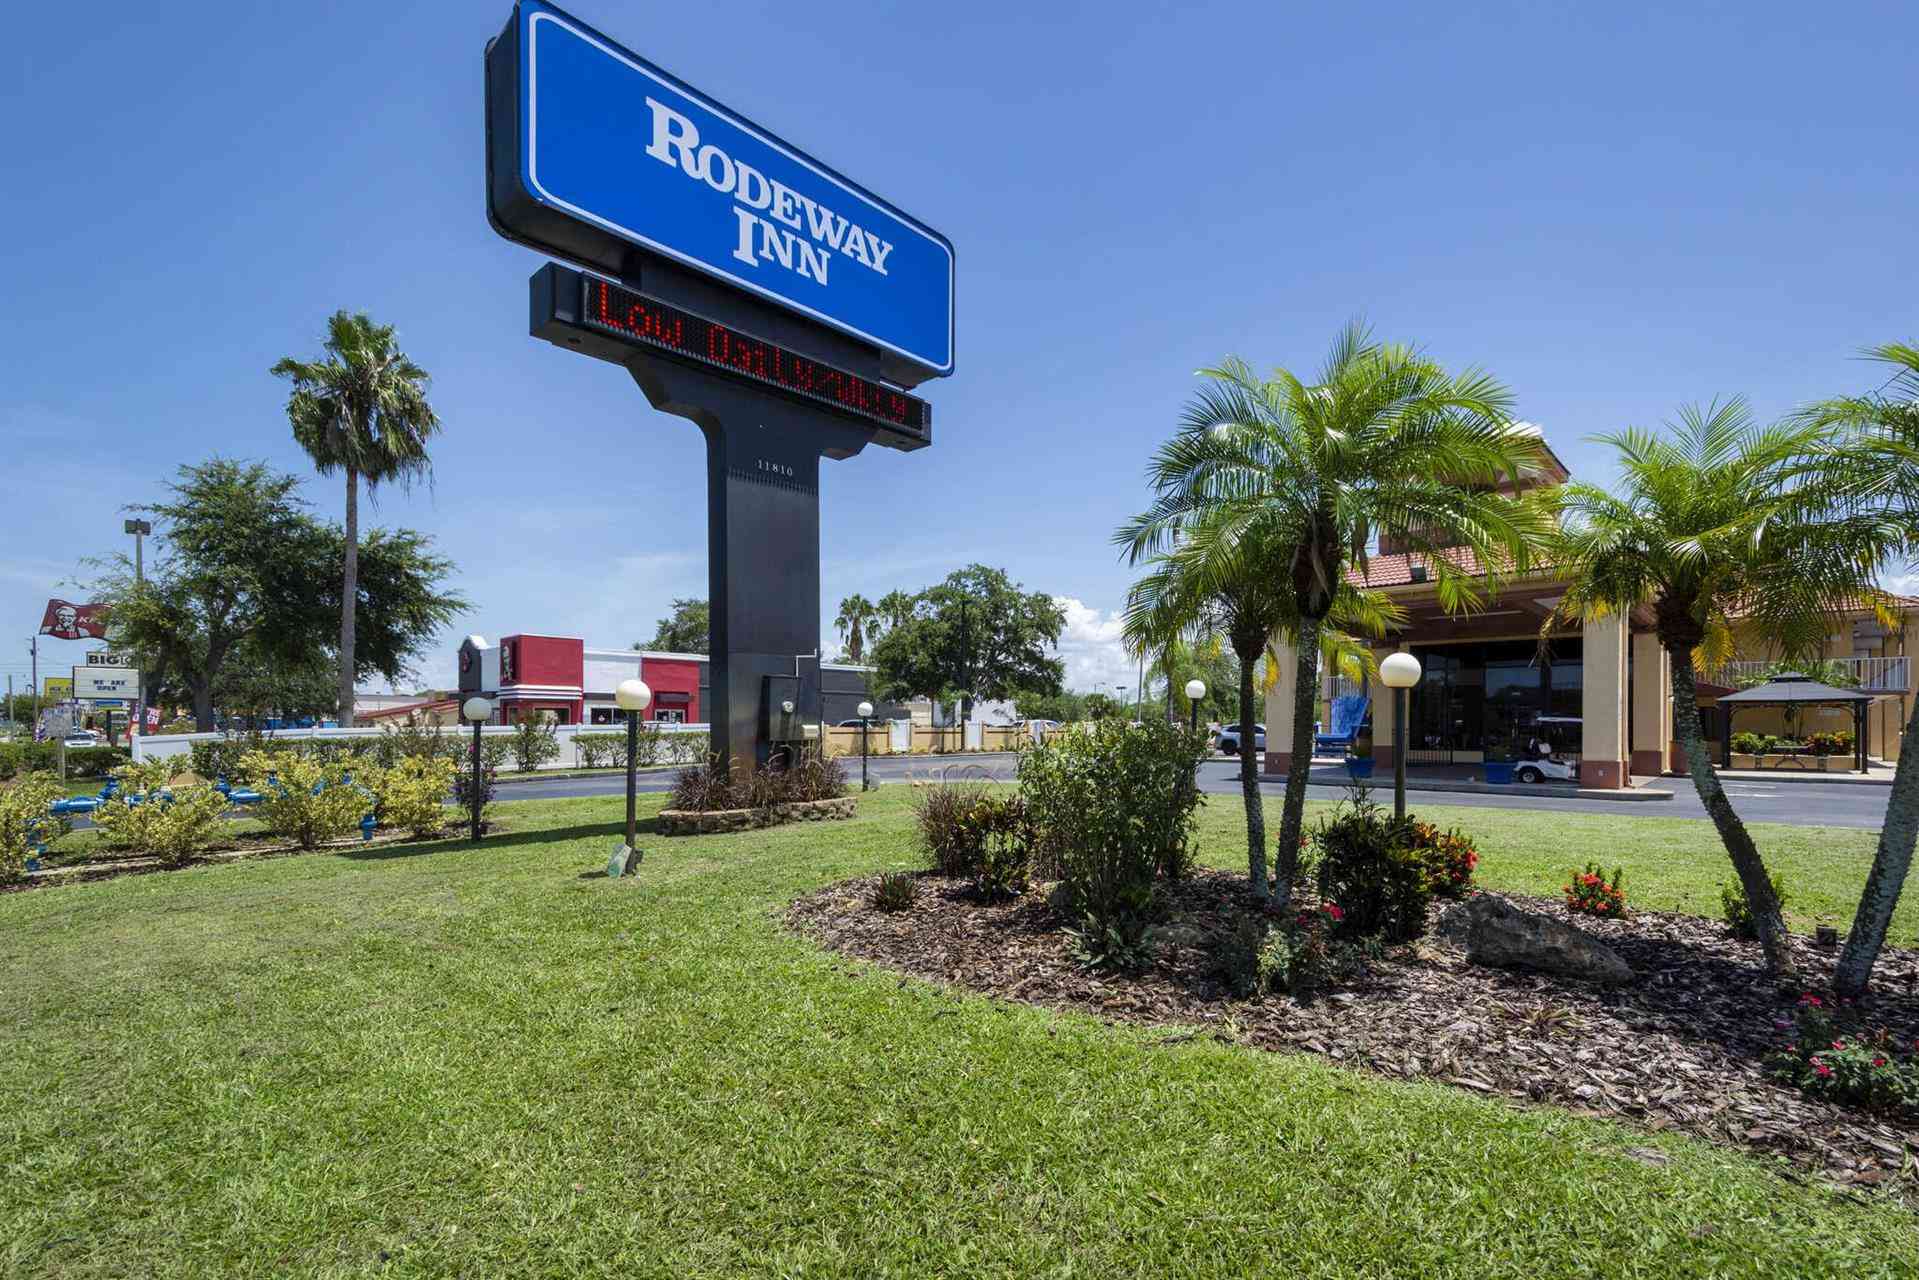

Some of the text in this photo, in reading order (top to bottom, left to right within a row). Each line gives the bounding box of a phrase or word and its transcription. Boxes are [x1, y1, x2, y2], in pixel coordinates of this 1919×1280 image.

[645, 95, 894, 276] RODEWAY
[732, 205, 831, 287] INN
[599, 281, 685, 349] Low
[757, 459, 793, 477] 11810
[88, 655, 120, 665] BIG
